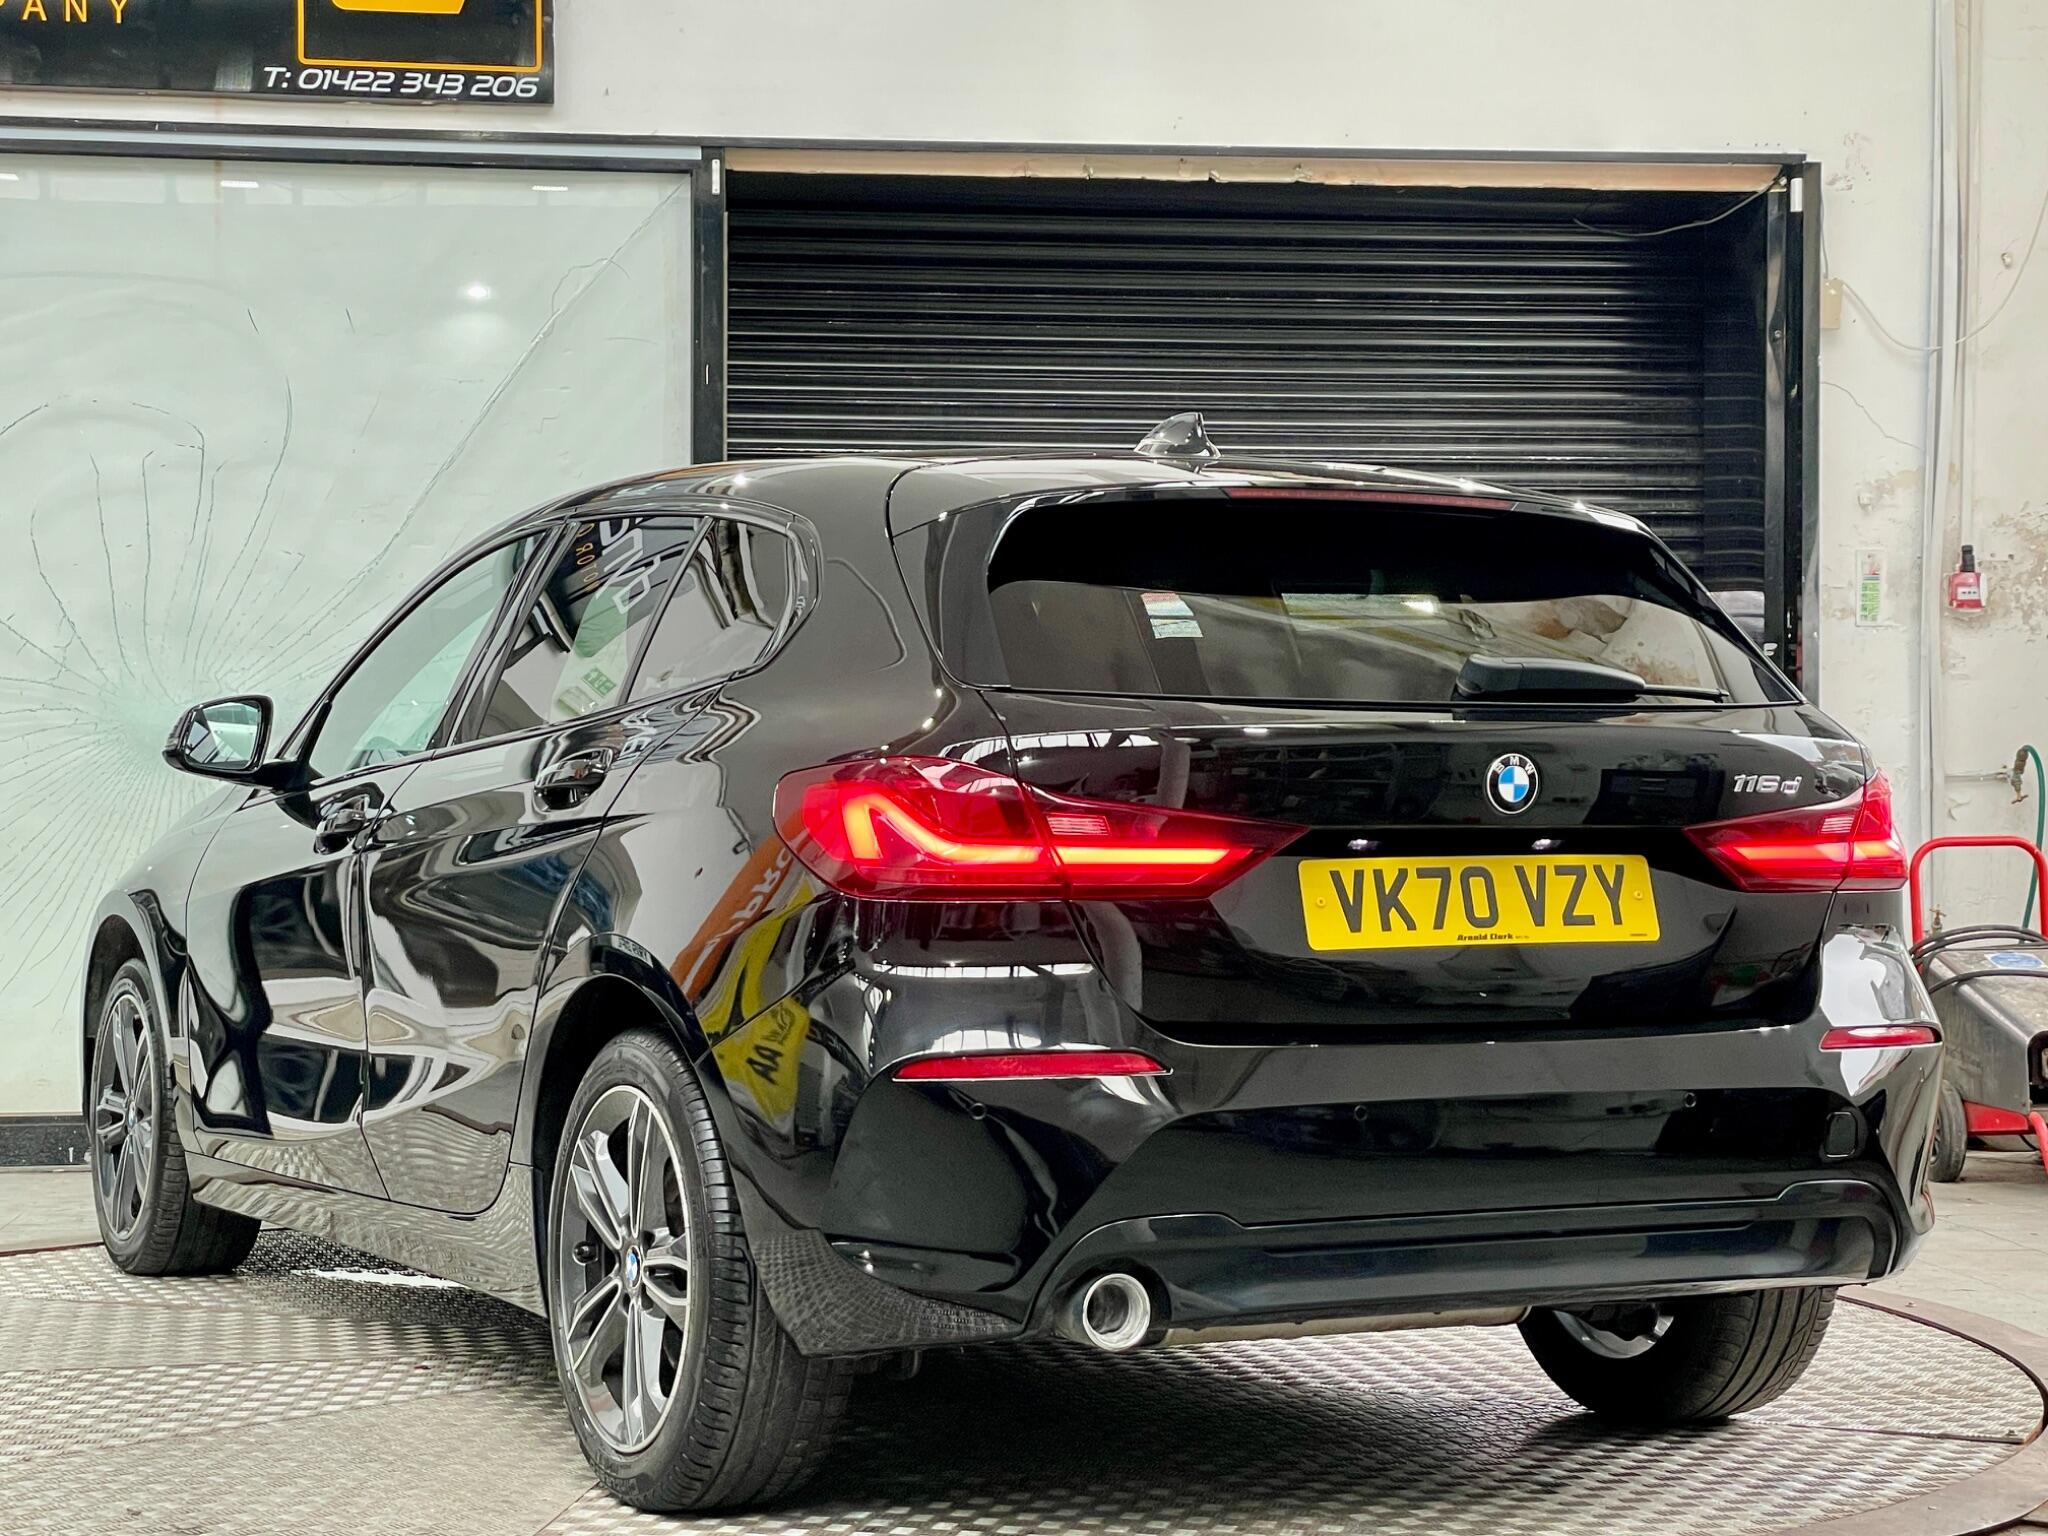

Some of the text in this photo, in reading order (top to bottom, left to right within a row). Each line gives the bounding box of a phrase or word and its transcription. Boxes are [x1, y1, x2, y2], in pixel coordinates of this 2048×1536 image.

[0, 0, 128, 24] ANY
[264, 66, 540, 98] T: 01422 343 206
[1493, 755, 1535, 775] BMW
[1733, 774, 1803, 794] 116d
[1329, 864, 1625, 934] VK70 VZY
